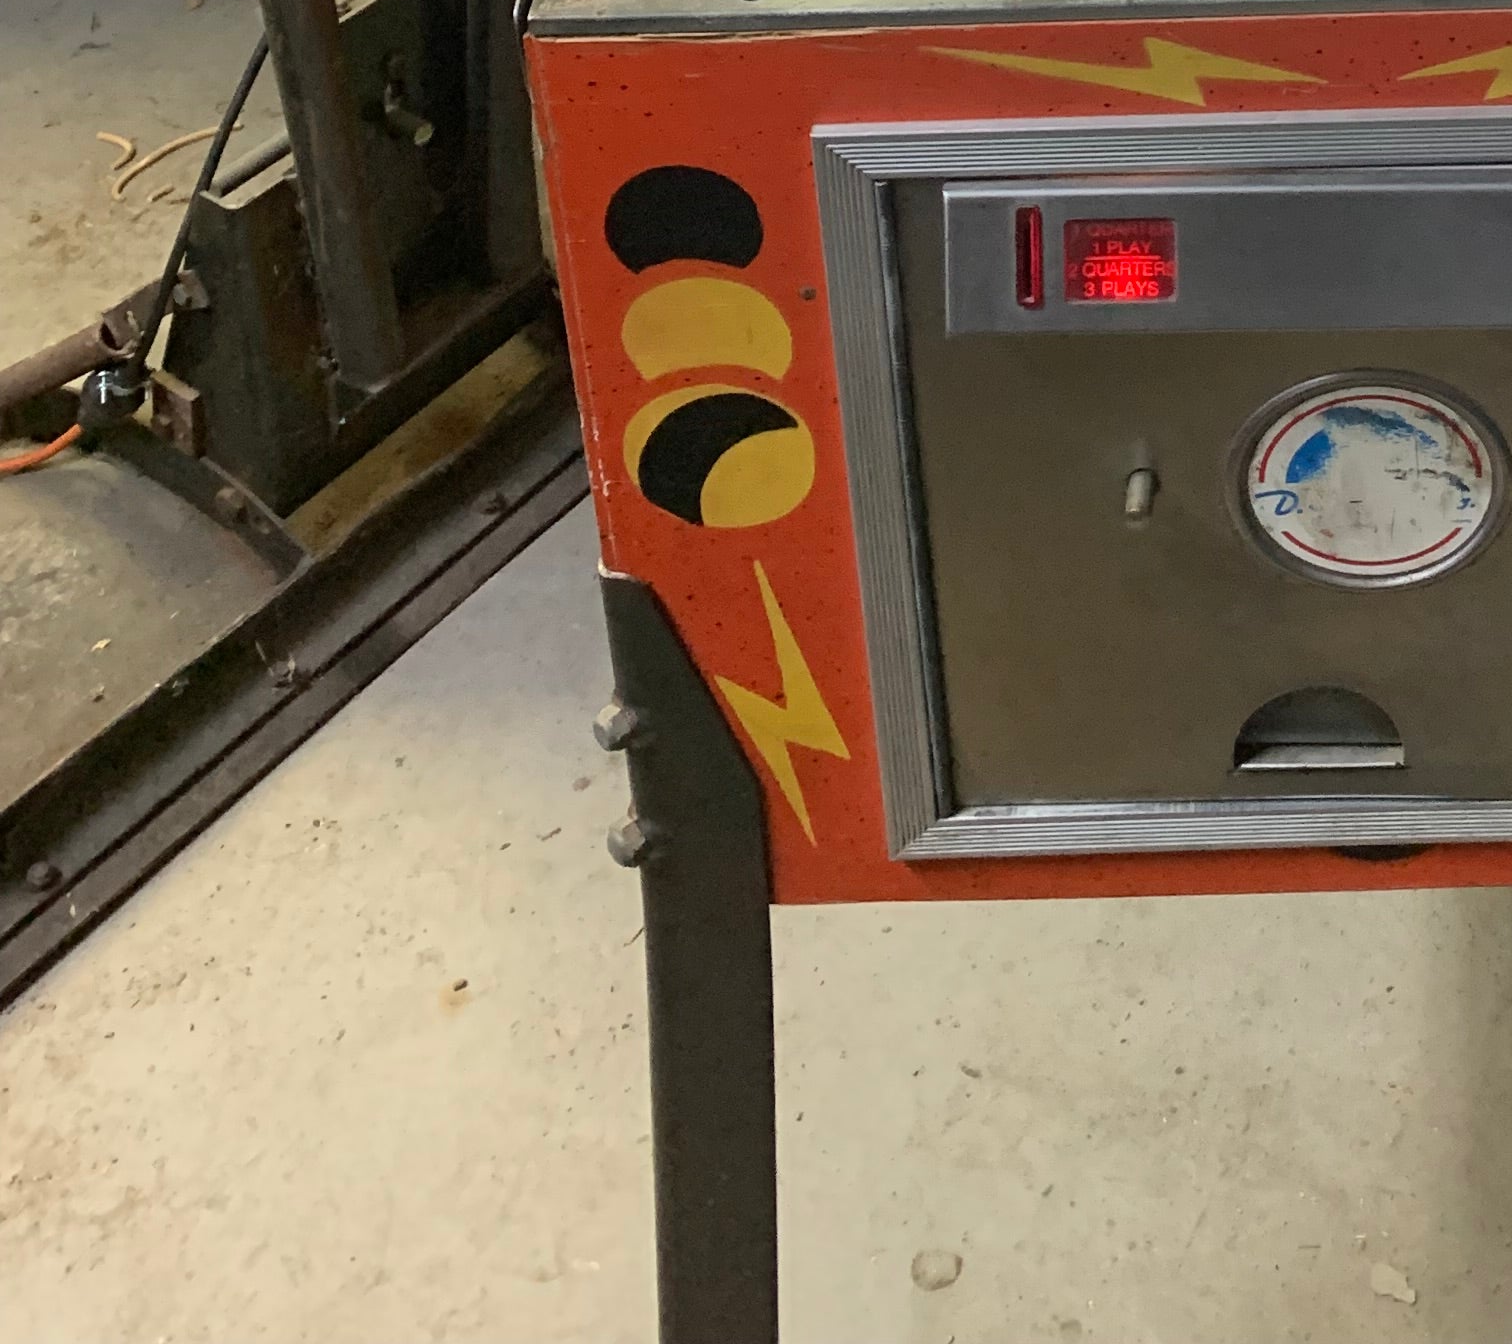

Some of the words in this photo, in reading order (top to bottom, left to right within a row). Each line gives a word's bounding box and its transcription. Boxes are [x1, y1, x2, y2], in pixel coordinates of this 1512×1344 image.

[1093, 242, 1100, 254] 1
[1106, 240, 1152, 254] PLAY
[1082, 261, 1176, 278] QUARTERS
[1084, 281, 1096, 297] 3
[1102, 280, 1160, 297] PLAYS
